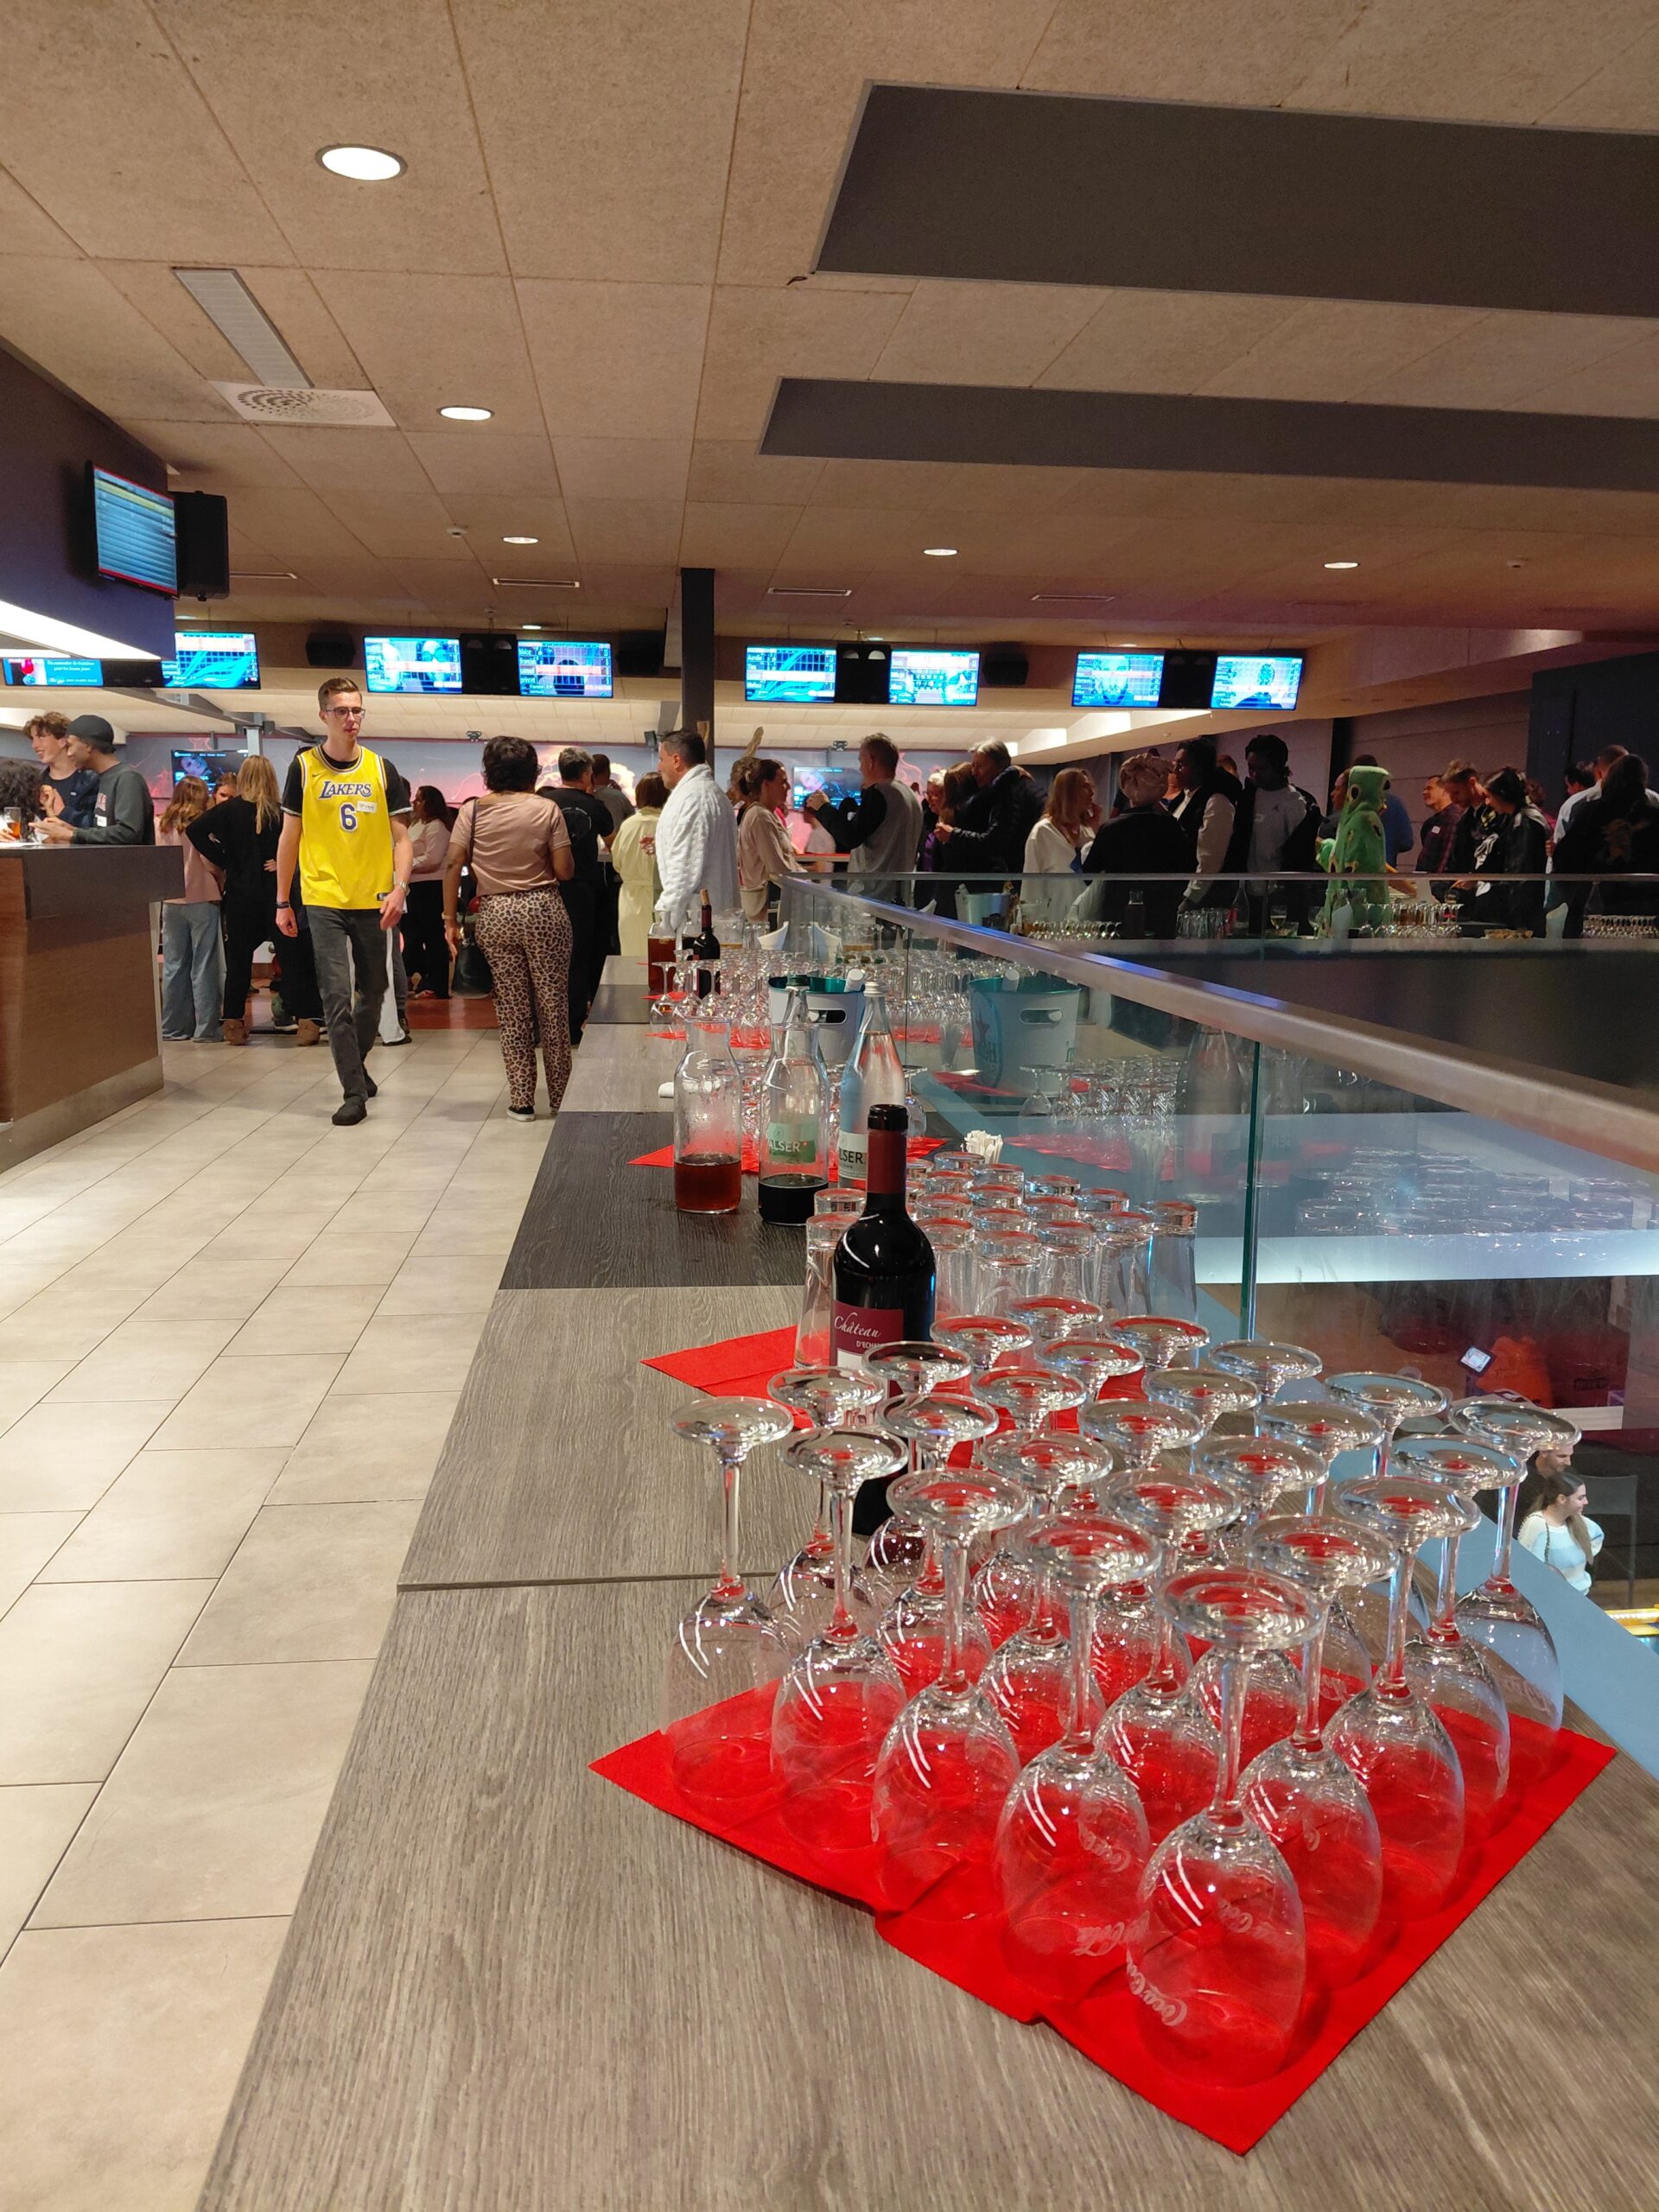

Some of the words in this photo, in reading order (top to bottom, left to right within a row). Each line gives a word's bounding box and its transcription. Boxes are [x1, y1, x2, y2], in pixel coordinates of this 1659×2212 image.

[318, 780, 372, 799] LAKERS
[340, 804, 357, 830] 6
[768, 1139, 801, 1153] ALSER
[834, 1312, 881, 1338] Château
